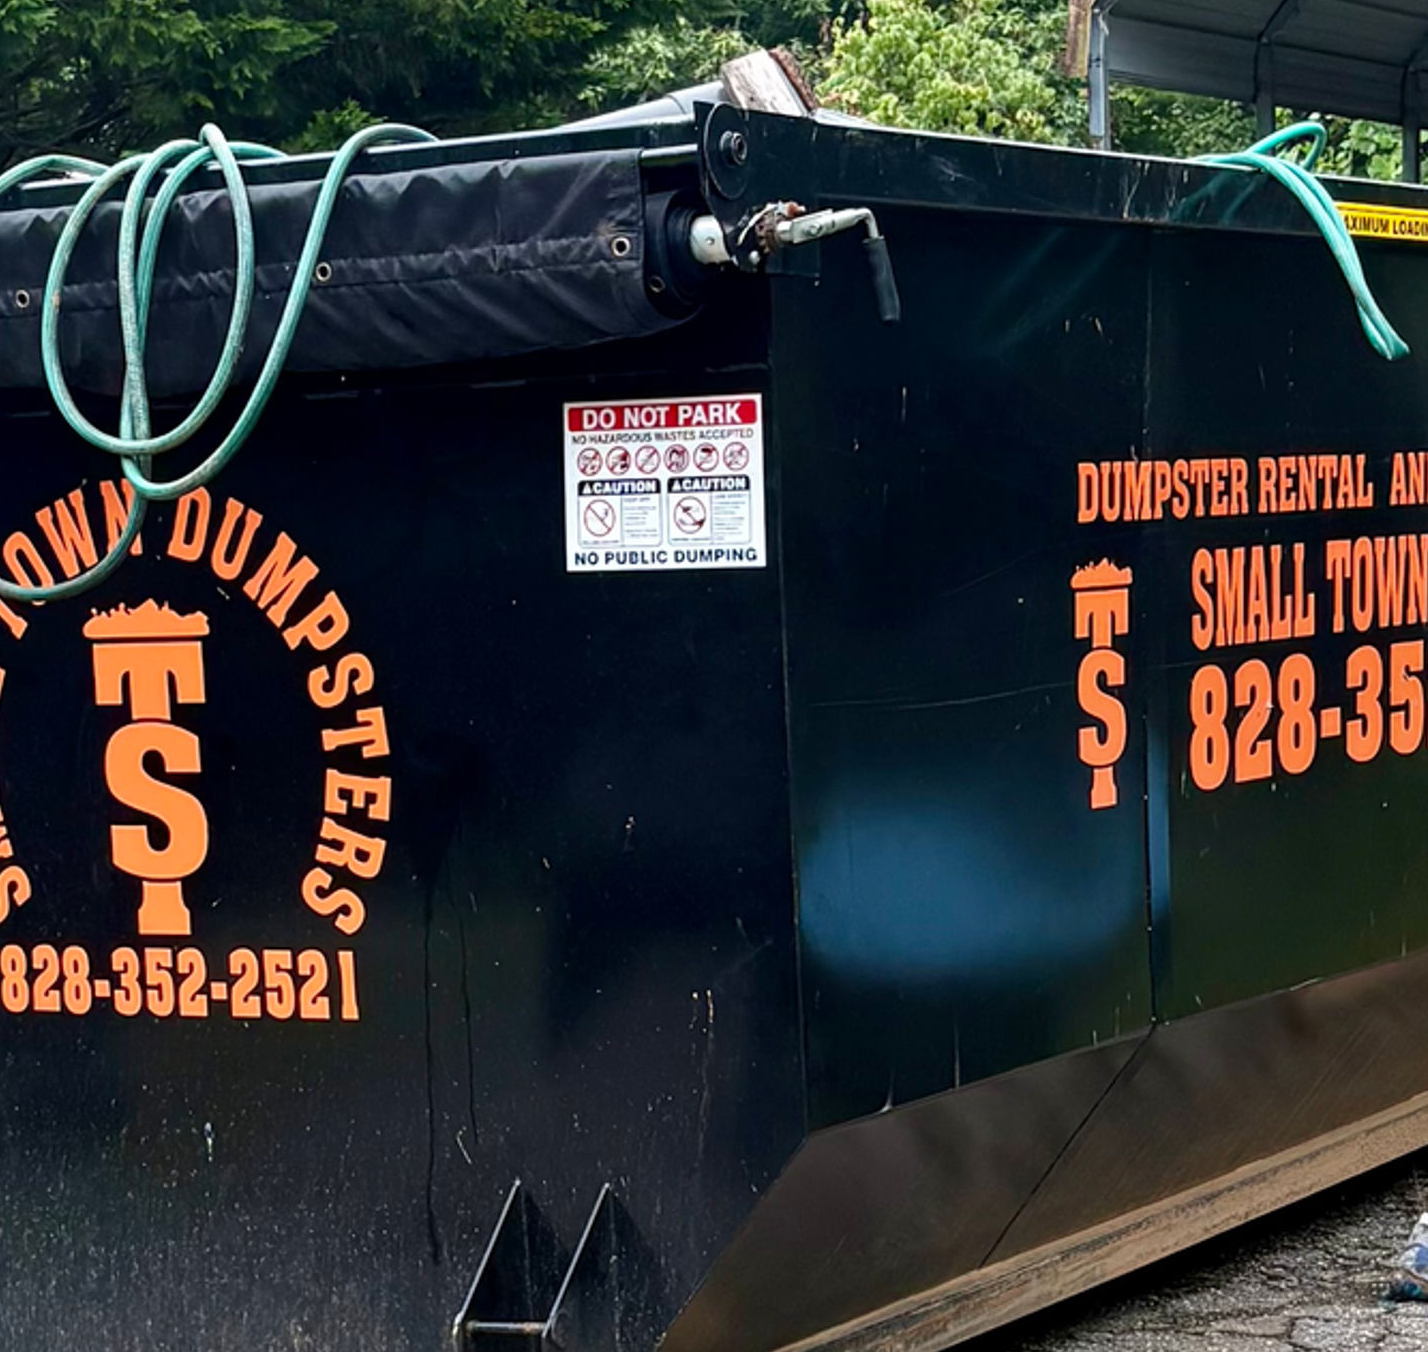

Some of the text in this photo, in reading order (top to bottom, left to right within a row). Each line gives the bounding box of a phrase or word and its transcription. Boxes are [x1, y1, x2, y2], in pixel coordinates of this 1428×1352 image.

[1343, 214, 1390, 234] AXIMUM
[582, 402, 742, 430] DO NOT PARK
[572, 427, 754, 445] NO HAZARDOUS WASTES ACCEPTED
[592, 480, 657, 495] CAUTION
[681, 477, 746, 492] CAUTION
[1077, 459, 1250, 524] DUMPSTER
[1258, 455, 1373, 515] RENTAL
[573, 547, 758, 566] NO PUBLIC DUMPING
[1190, 542, 1316, 652] SMALL
[167, 486, 392, 936] DUMPSTERS
